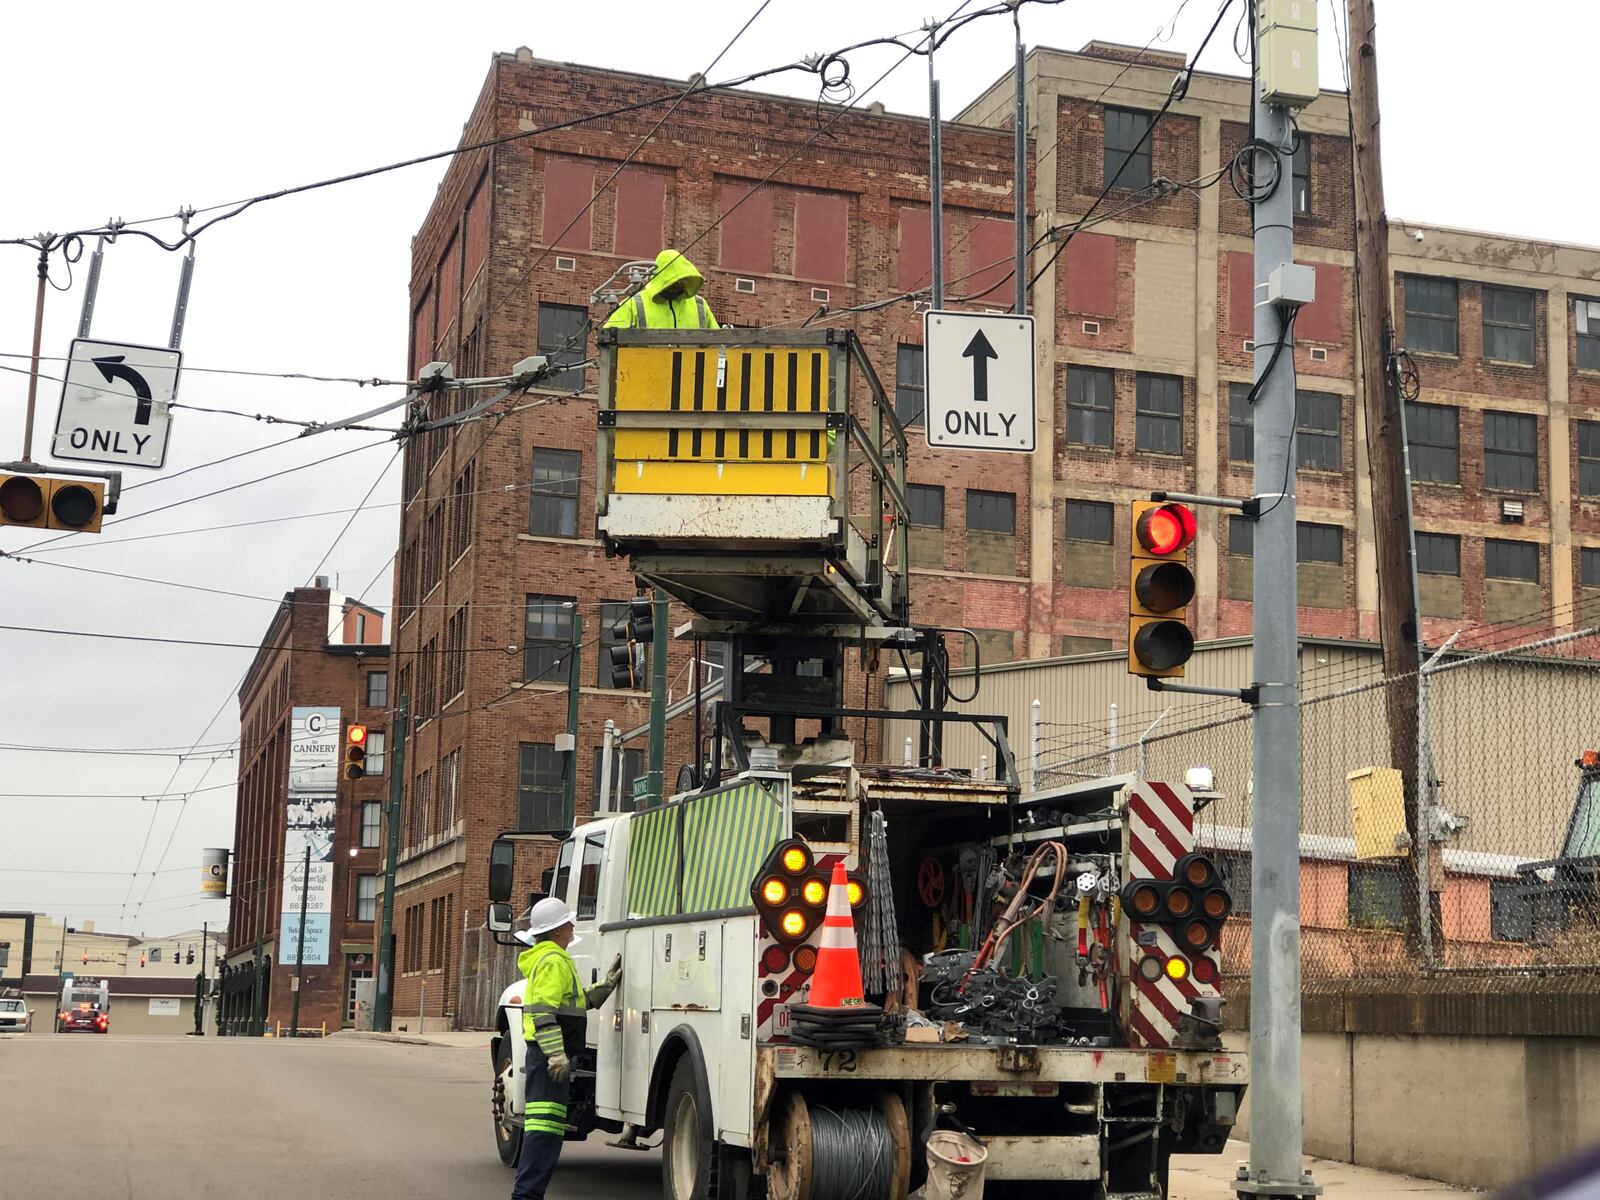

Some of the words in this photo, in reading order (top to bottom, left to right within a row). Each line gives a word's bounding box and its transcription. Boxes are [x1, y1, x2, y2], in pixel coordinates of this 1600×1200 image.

[945, 409, 1017, 437] ONLY
[70, 427, 152, 455] ONLY
[310, 716, 320, 732] C
[293, 744, 336, 753] CANNERY
[211, 865, 220, 876] C
[818, 1049, 857, 1072] 72
